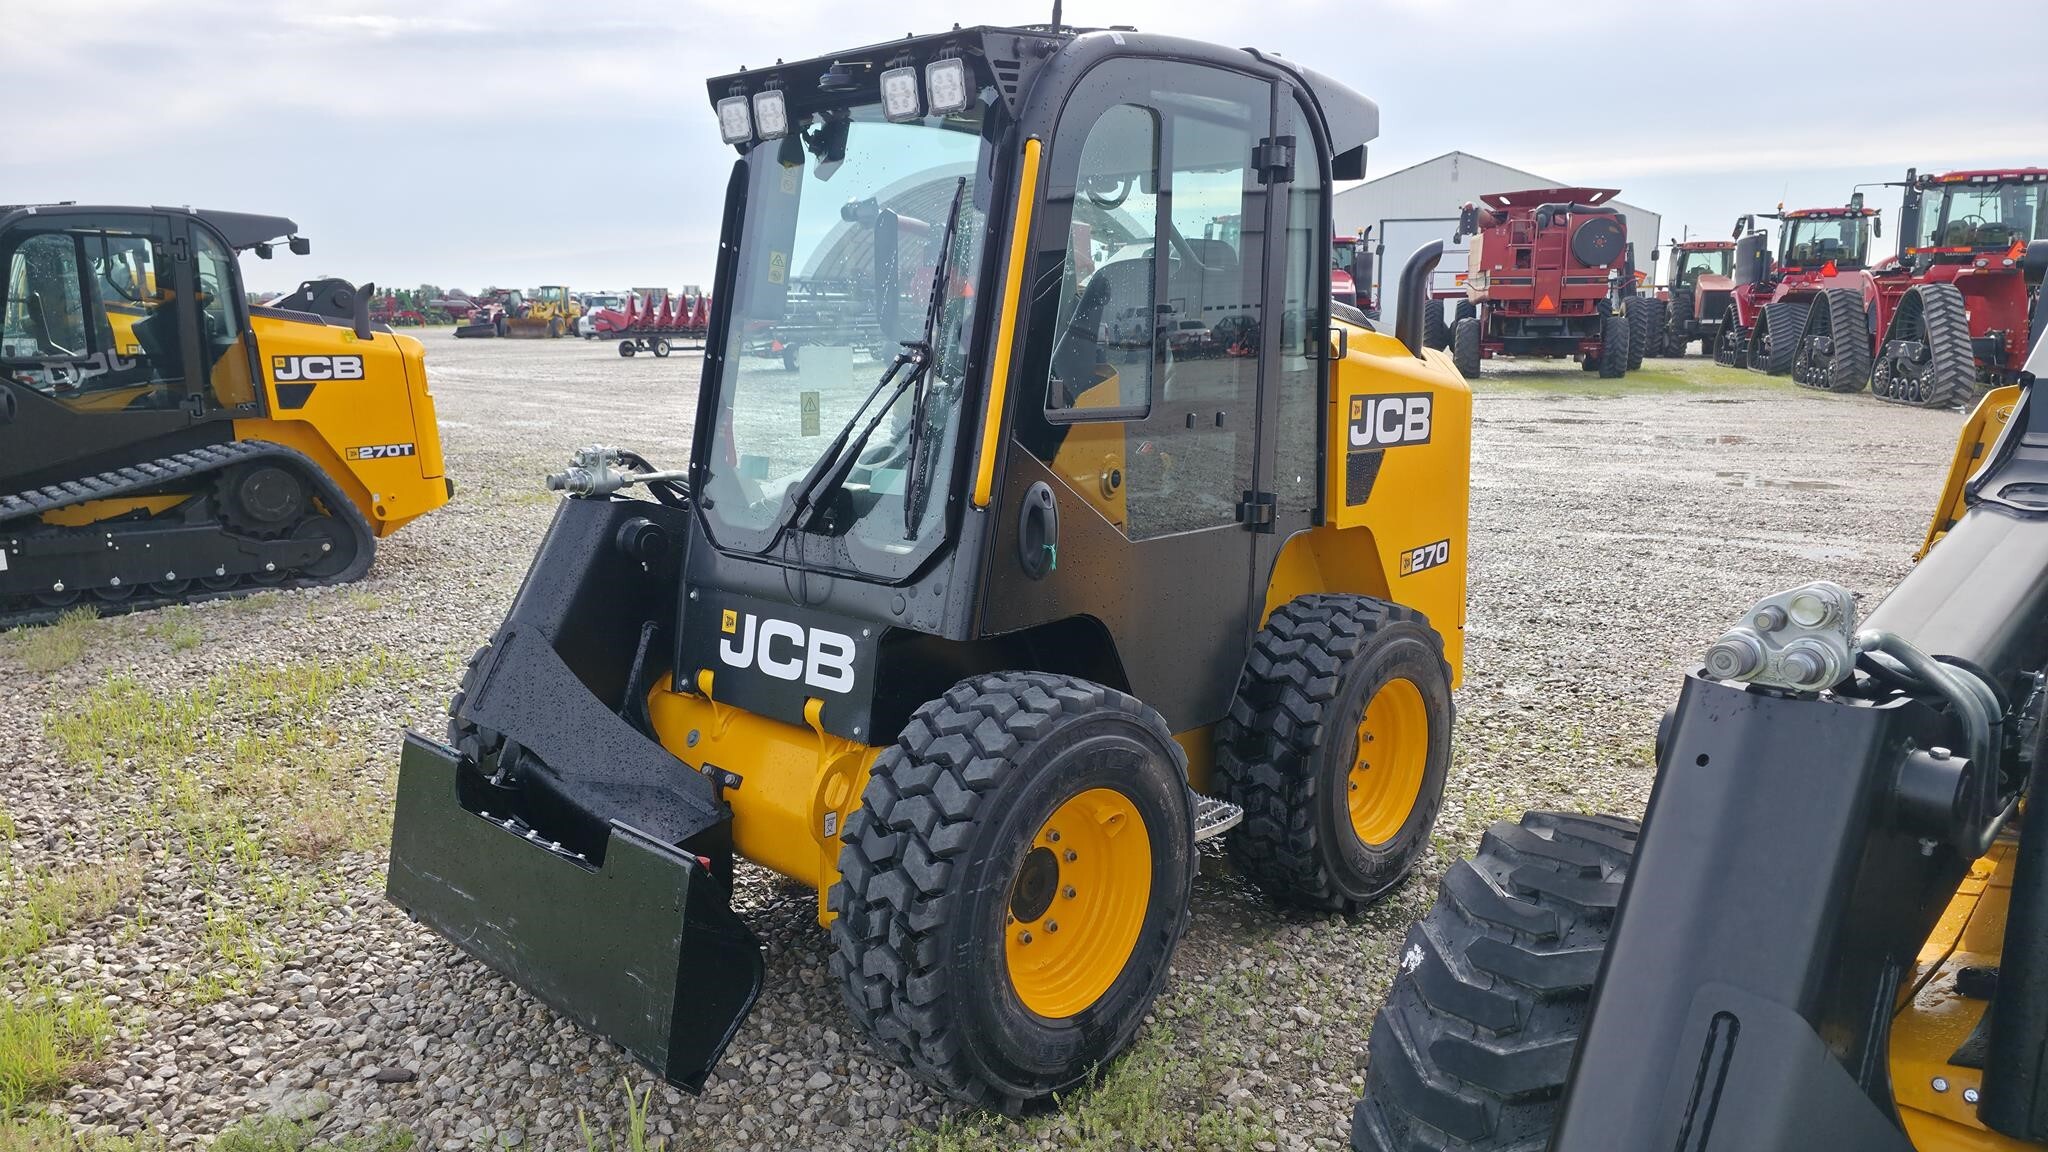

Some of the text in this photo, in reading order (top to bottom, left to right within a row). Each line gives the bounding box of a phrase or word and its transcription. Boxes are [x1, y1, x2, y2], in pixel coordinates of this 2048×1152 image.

[275, 356, 363, 380] JCB
[1350, 396, 1431, 446] JCB
[359, 443, 413, 459] 270T
[1411, 541, 1449, 572] 270
[719, 613, 856, 694] JCB
